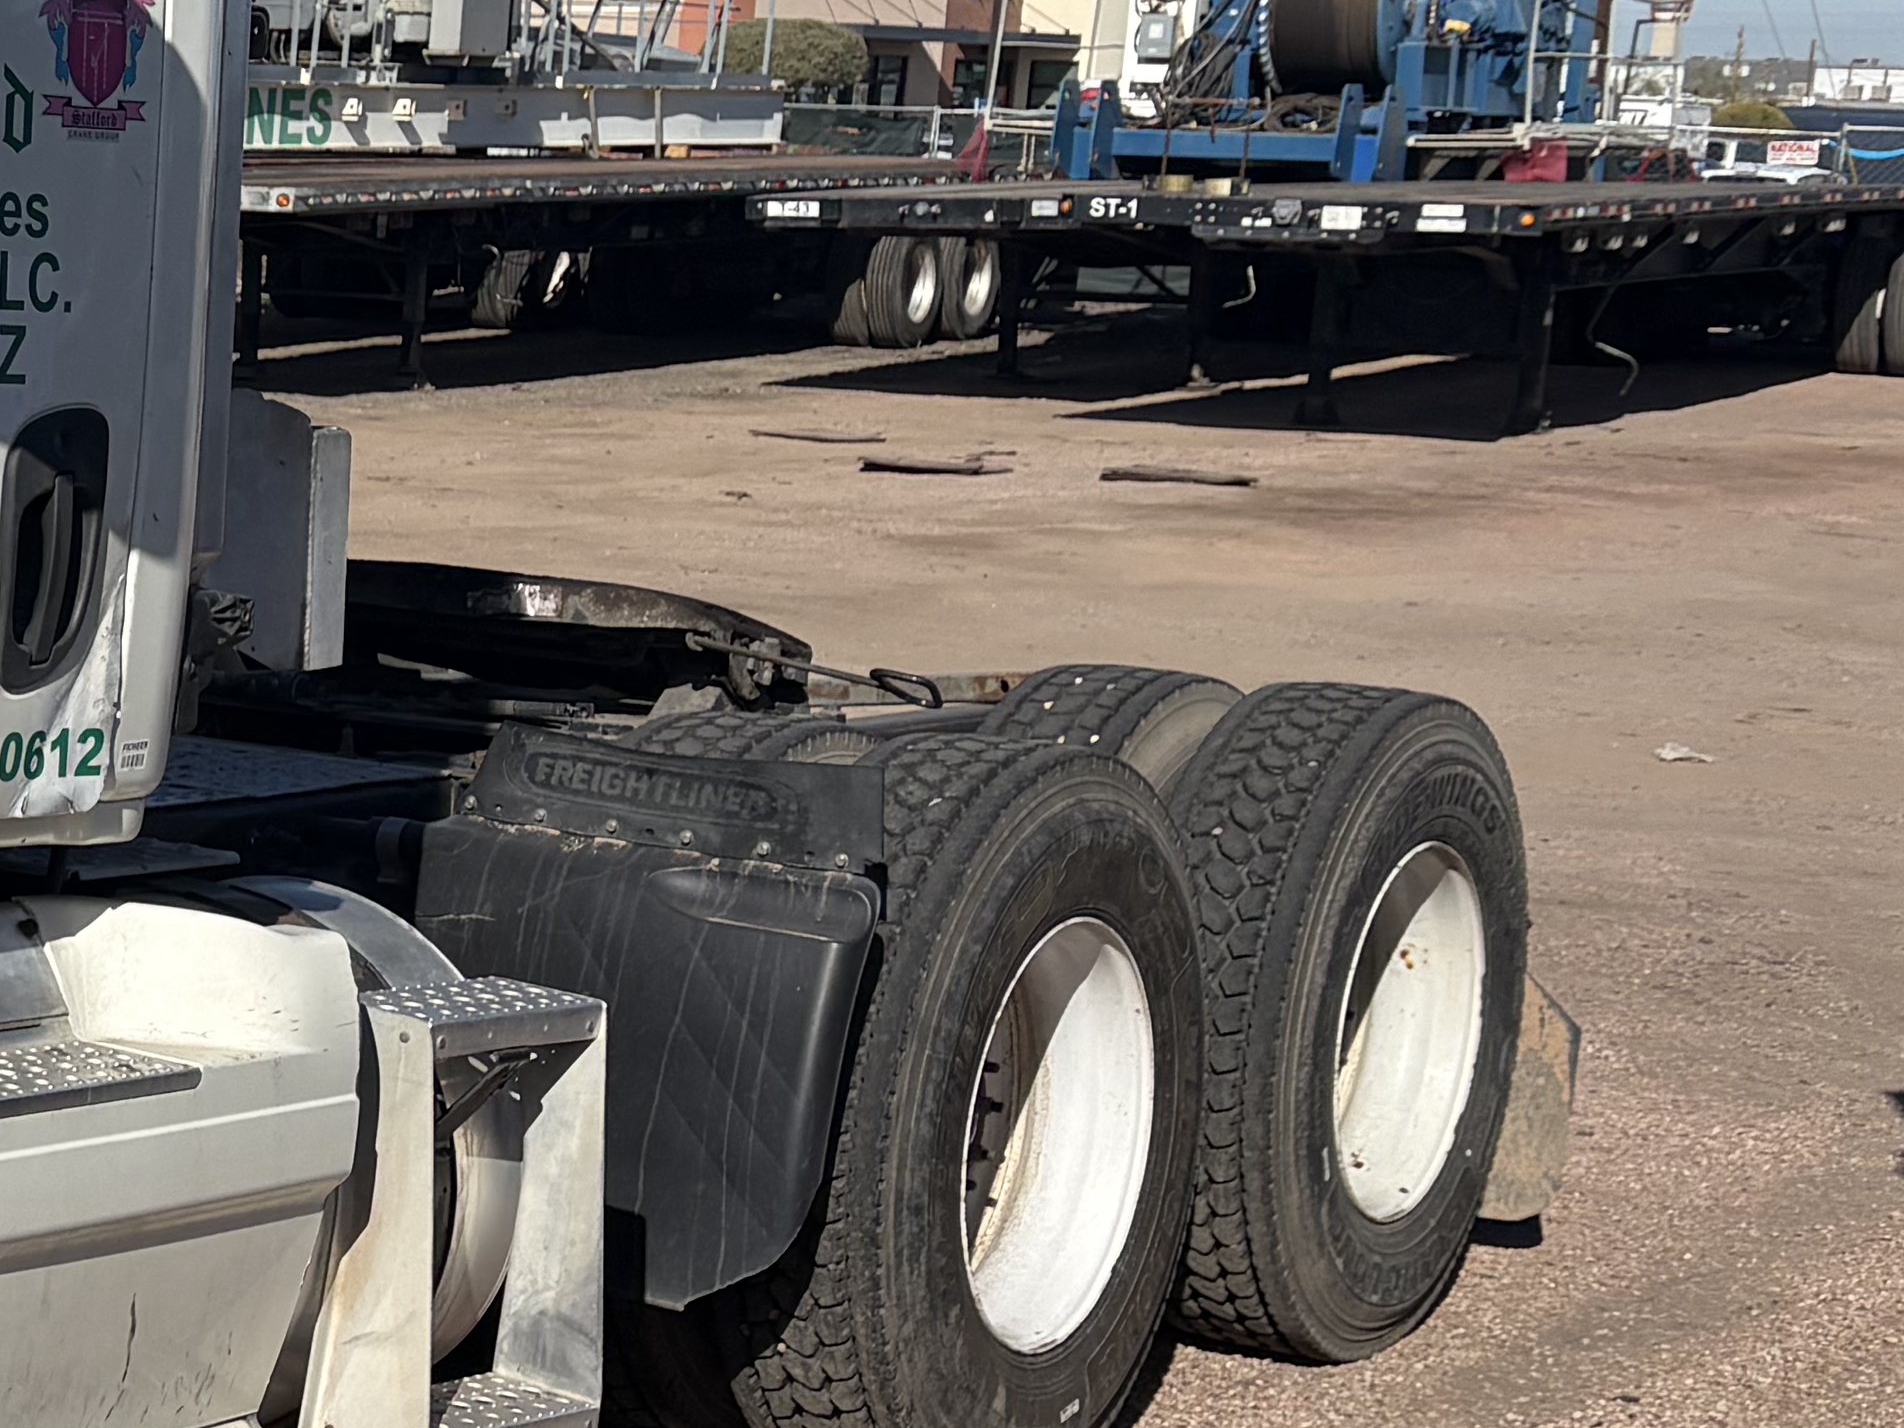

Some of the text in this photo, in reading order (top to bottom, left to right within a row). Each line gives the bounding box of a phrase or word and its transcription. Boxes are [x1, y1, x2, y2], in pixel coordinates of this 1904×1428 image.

[72, 110, 117, 128] Stafford
[1089, 197, 1138, 219] ST-1
[534, 757, 776, 821] FREIGHTLINER
